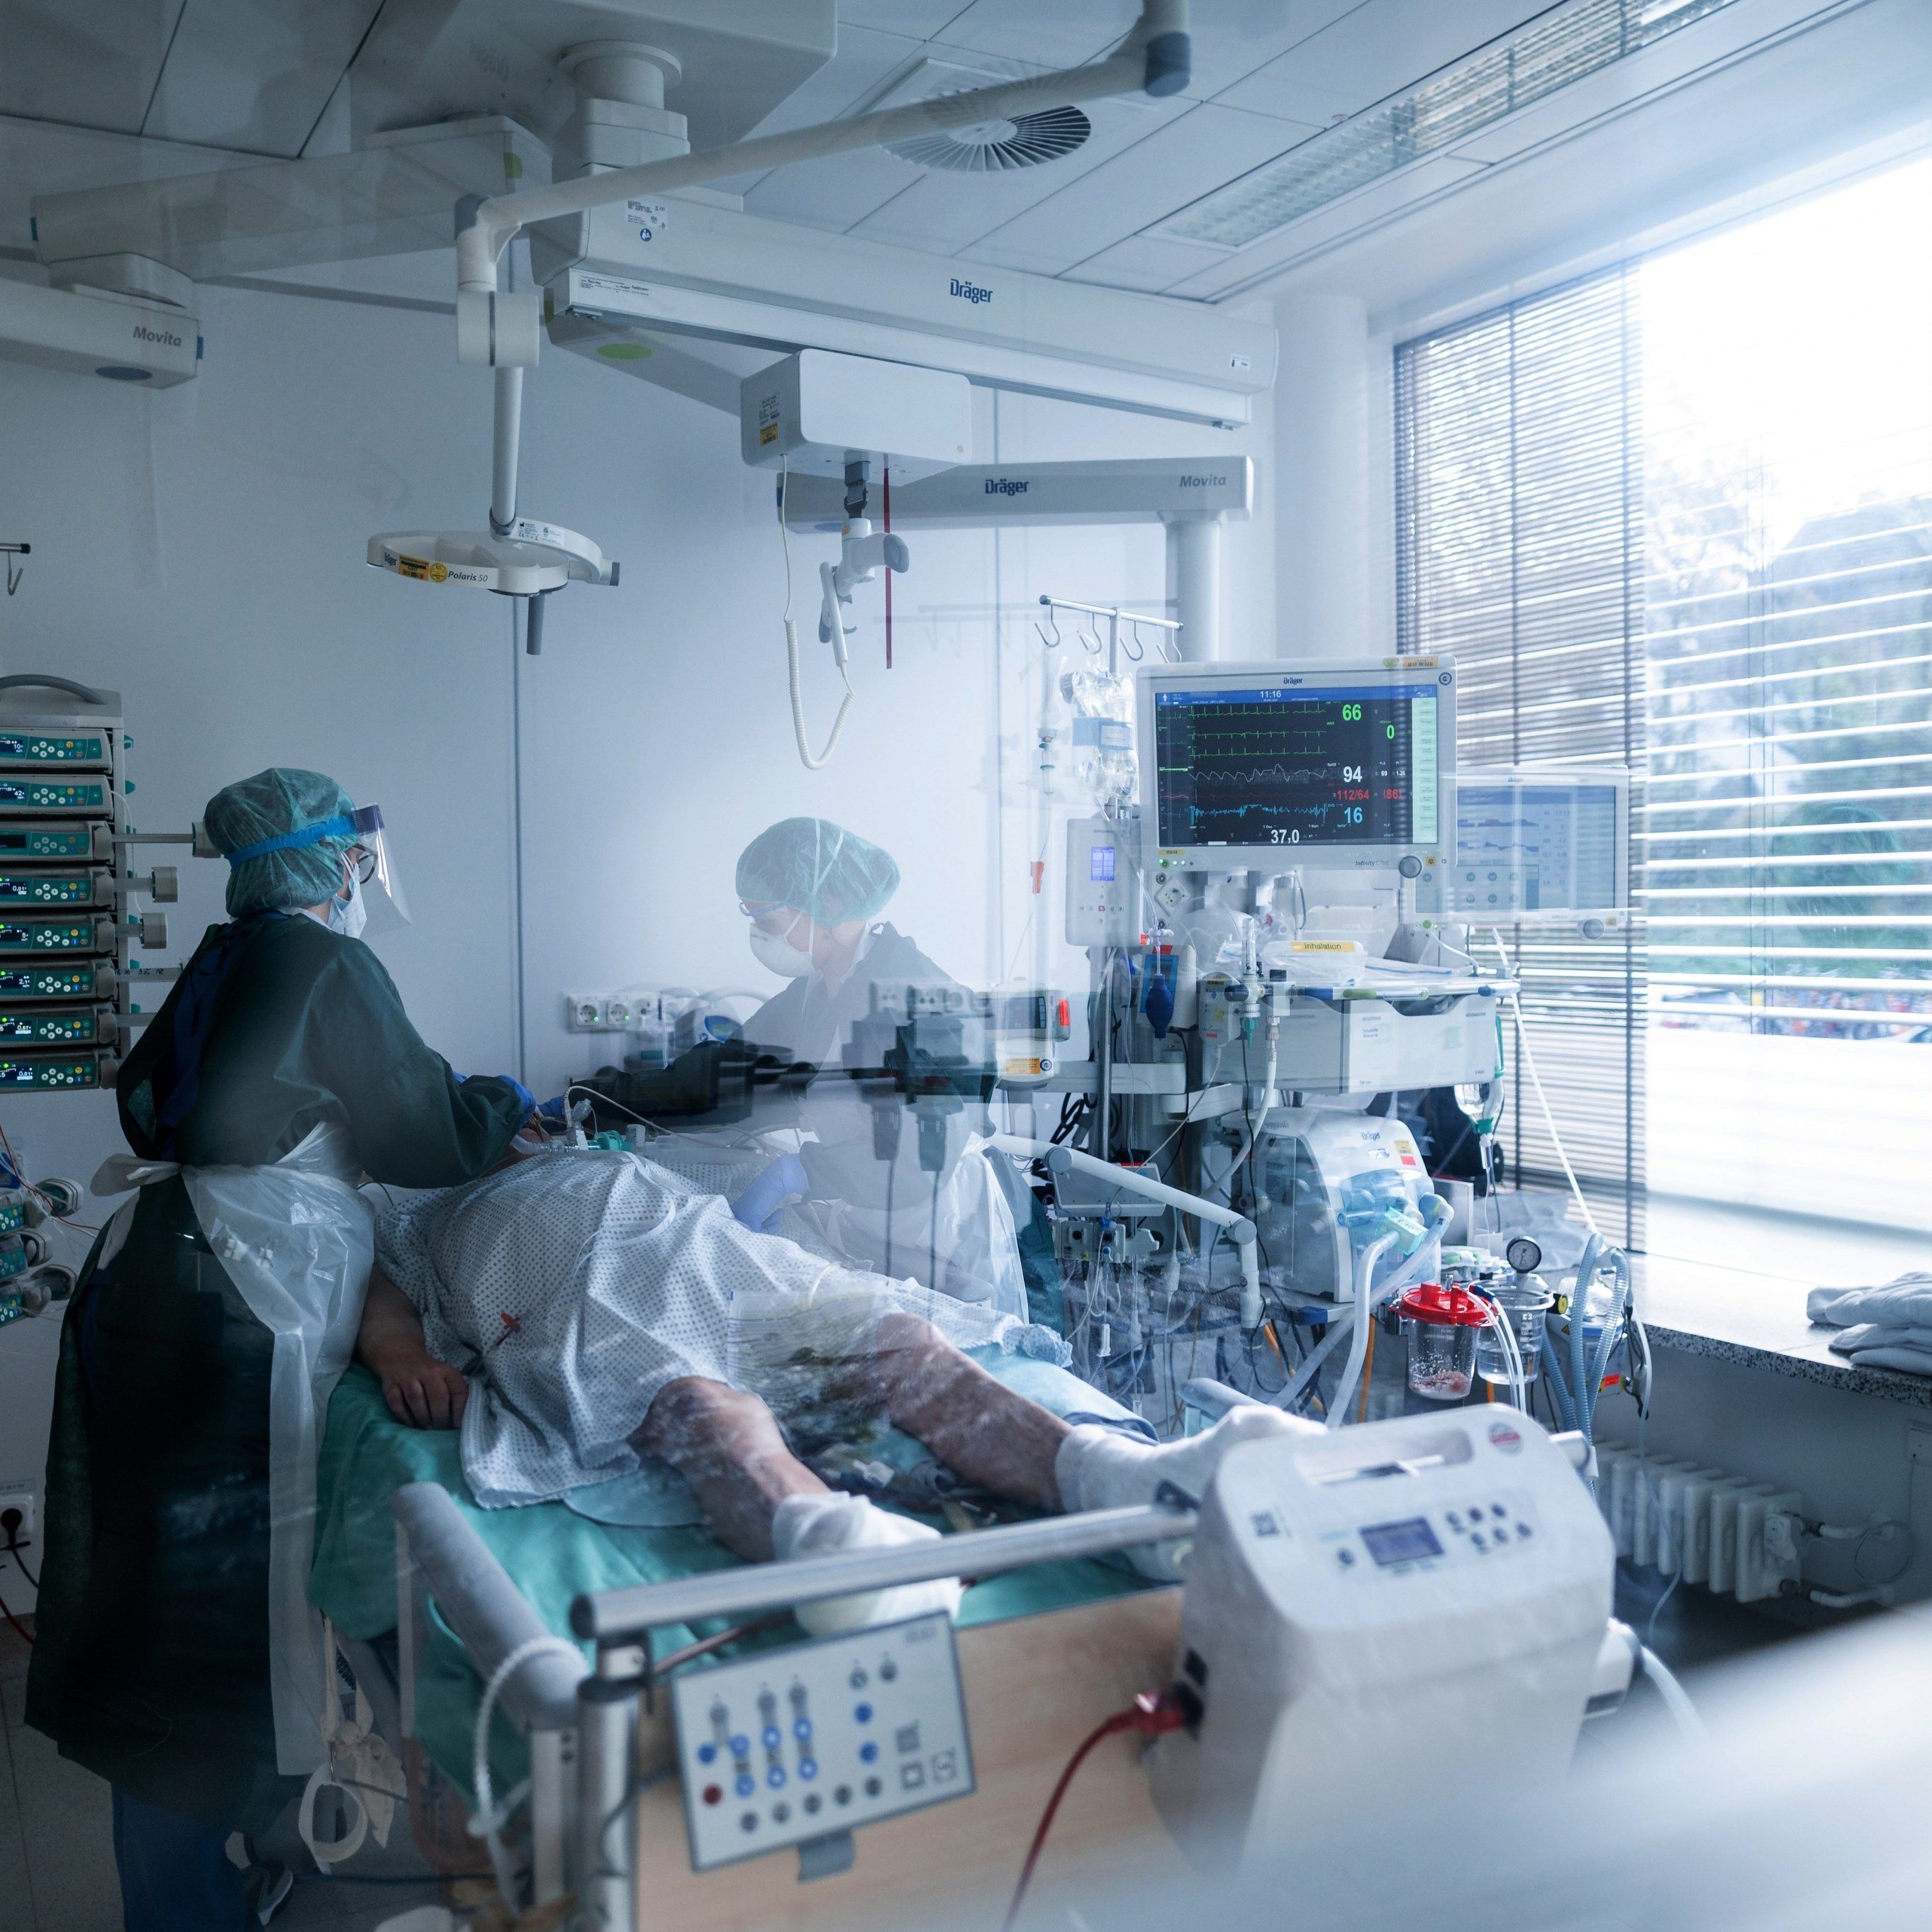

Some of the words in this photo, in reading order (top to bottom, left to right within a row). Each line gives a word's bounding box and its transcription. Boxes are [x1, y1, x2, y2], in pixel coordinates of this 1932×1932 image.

[950, 278, 993, 304] Dräger
[133, 326, 182, 347] Movita
[985, 479, 1029, 496] Dräger
[1180, 475, 1227, 488] Movita
[448, 570, 476, 581] Polaris
[1260, 690, 1281, 698] 11:16
[1342, 704, 1362, 721] 66
[1386, 725, 1395, 739] 0
[1343, 766, 1363, 783] 94
[1337, 789, 1370, 800] 112/64
[1344, 807, 1363, 824] 16
[1271, 829, 1300, 844] 37,0
